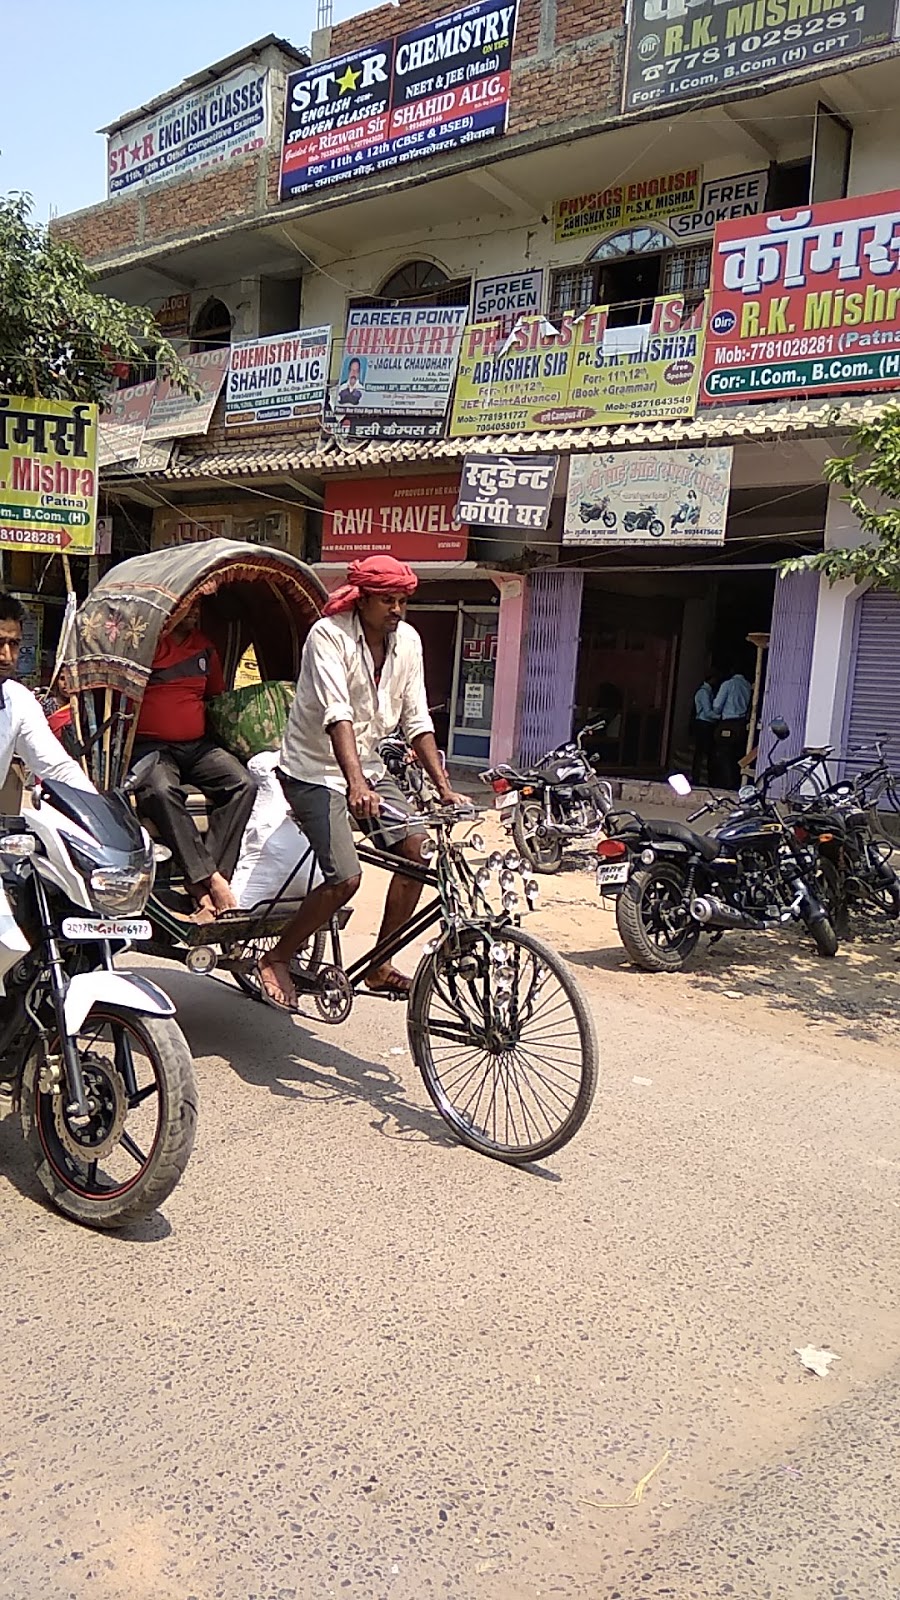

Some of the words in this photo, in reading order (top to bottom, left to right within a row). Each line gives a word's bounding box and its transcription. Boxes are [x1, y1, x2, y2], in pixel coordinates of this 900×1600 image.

[396, 5, 514, 75] CHEMISTRY
[664, 16, 718, 57] R.K.
[726, 0, 856, 40] MISH
[665, 6, 864, 75] 7781028281
[723, 56, 776, 79] B.Com
[782, 48, 807, 66] (H)
[815, 35, 849, 54] CPT
[405, 78, 434, 99] NEET
[435, 75, 444, 88] &
[444, 67, 464, 89] JEE
[466, 54, 500, 80] (Main)
[158, 105, 207, 152] ENGLISH
[210, 77, 265, 126] CLASSES
[301, 96, 351, 124] ENGLISH
[392, 92, 455, 128] SHAHID
[459, 76, 505, 107] ALIG.
[287, 118, 334, 144] SPOKEN
[336, 99, 387, 127] CLASSES
[319, 126, 364, 150] Rizwan
[367, 117, 386, 135] Sir
[187, 126, 233, 152] Competitive
[331, 154, 352, 169] 11th
[355, 151, 363, 161] &
[367, 141, 390, 158] 12th
[392, 131, 424, 152] (CBSE
[427, 128, 436, 138] &
[440, 116, 474, 135] BSEB)
[560, 186, 623, 217] PHYSICS
[627, 169, 698, 201] ENGLISH
[707, 179, 759, 205] FREE
[564, 209, 605, 231] ABHISHEK
[606, 205, 621, 220] SIR
[655, 189, 695, 210] MISHRA
[678, 201, 758, 232] SPOKEN
[718, 210, 900, 294] कॉमर
[476, 291, 537, 315] SPOKEN
[482, 278, 533, 298] FREE
[350, 312, 412, 326] CAREER
[415, 310, 465, 325] POINT
[740, 297, 795, 339] R.K.
[803, 284, 900, 332] Mishr
[231, 339, 300, 371] CHEMISTRY
[345, 327, 459, 355] CHEMISTRY
[404, 357, 454, 370] CHAUDHARY
[472, 354, 541, 385] ABHISHEK
[543, 351, 568, 377] SIR
[879, 356, 900, 378] (H
[230, 366, 282, 393] SHAHID
[571, 386, 599, 400] (Book
[12, 456, 94, 498] Mishra
[23, 508, 65, 522] B.Com.
[68, 512, 86, 525] (H)
[41, 495, 88, 510] (Patna)
[460, 496, 513, 524] कॉपी
[515, 504, 546, 527] घर
[332, 507, 373, 535] RAVI
[380, 504, 461, 533] TRAVELS
[0, 529, 61, 544] 81028281
